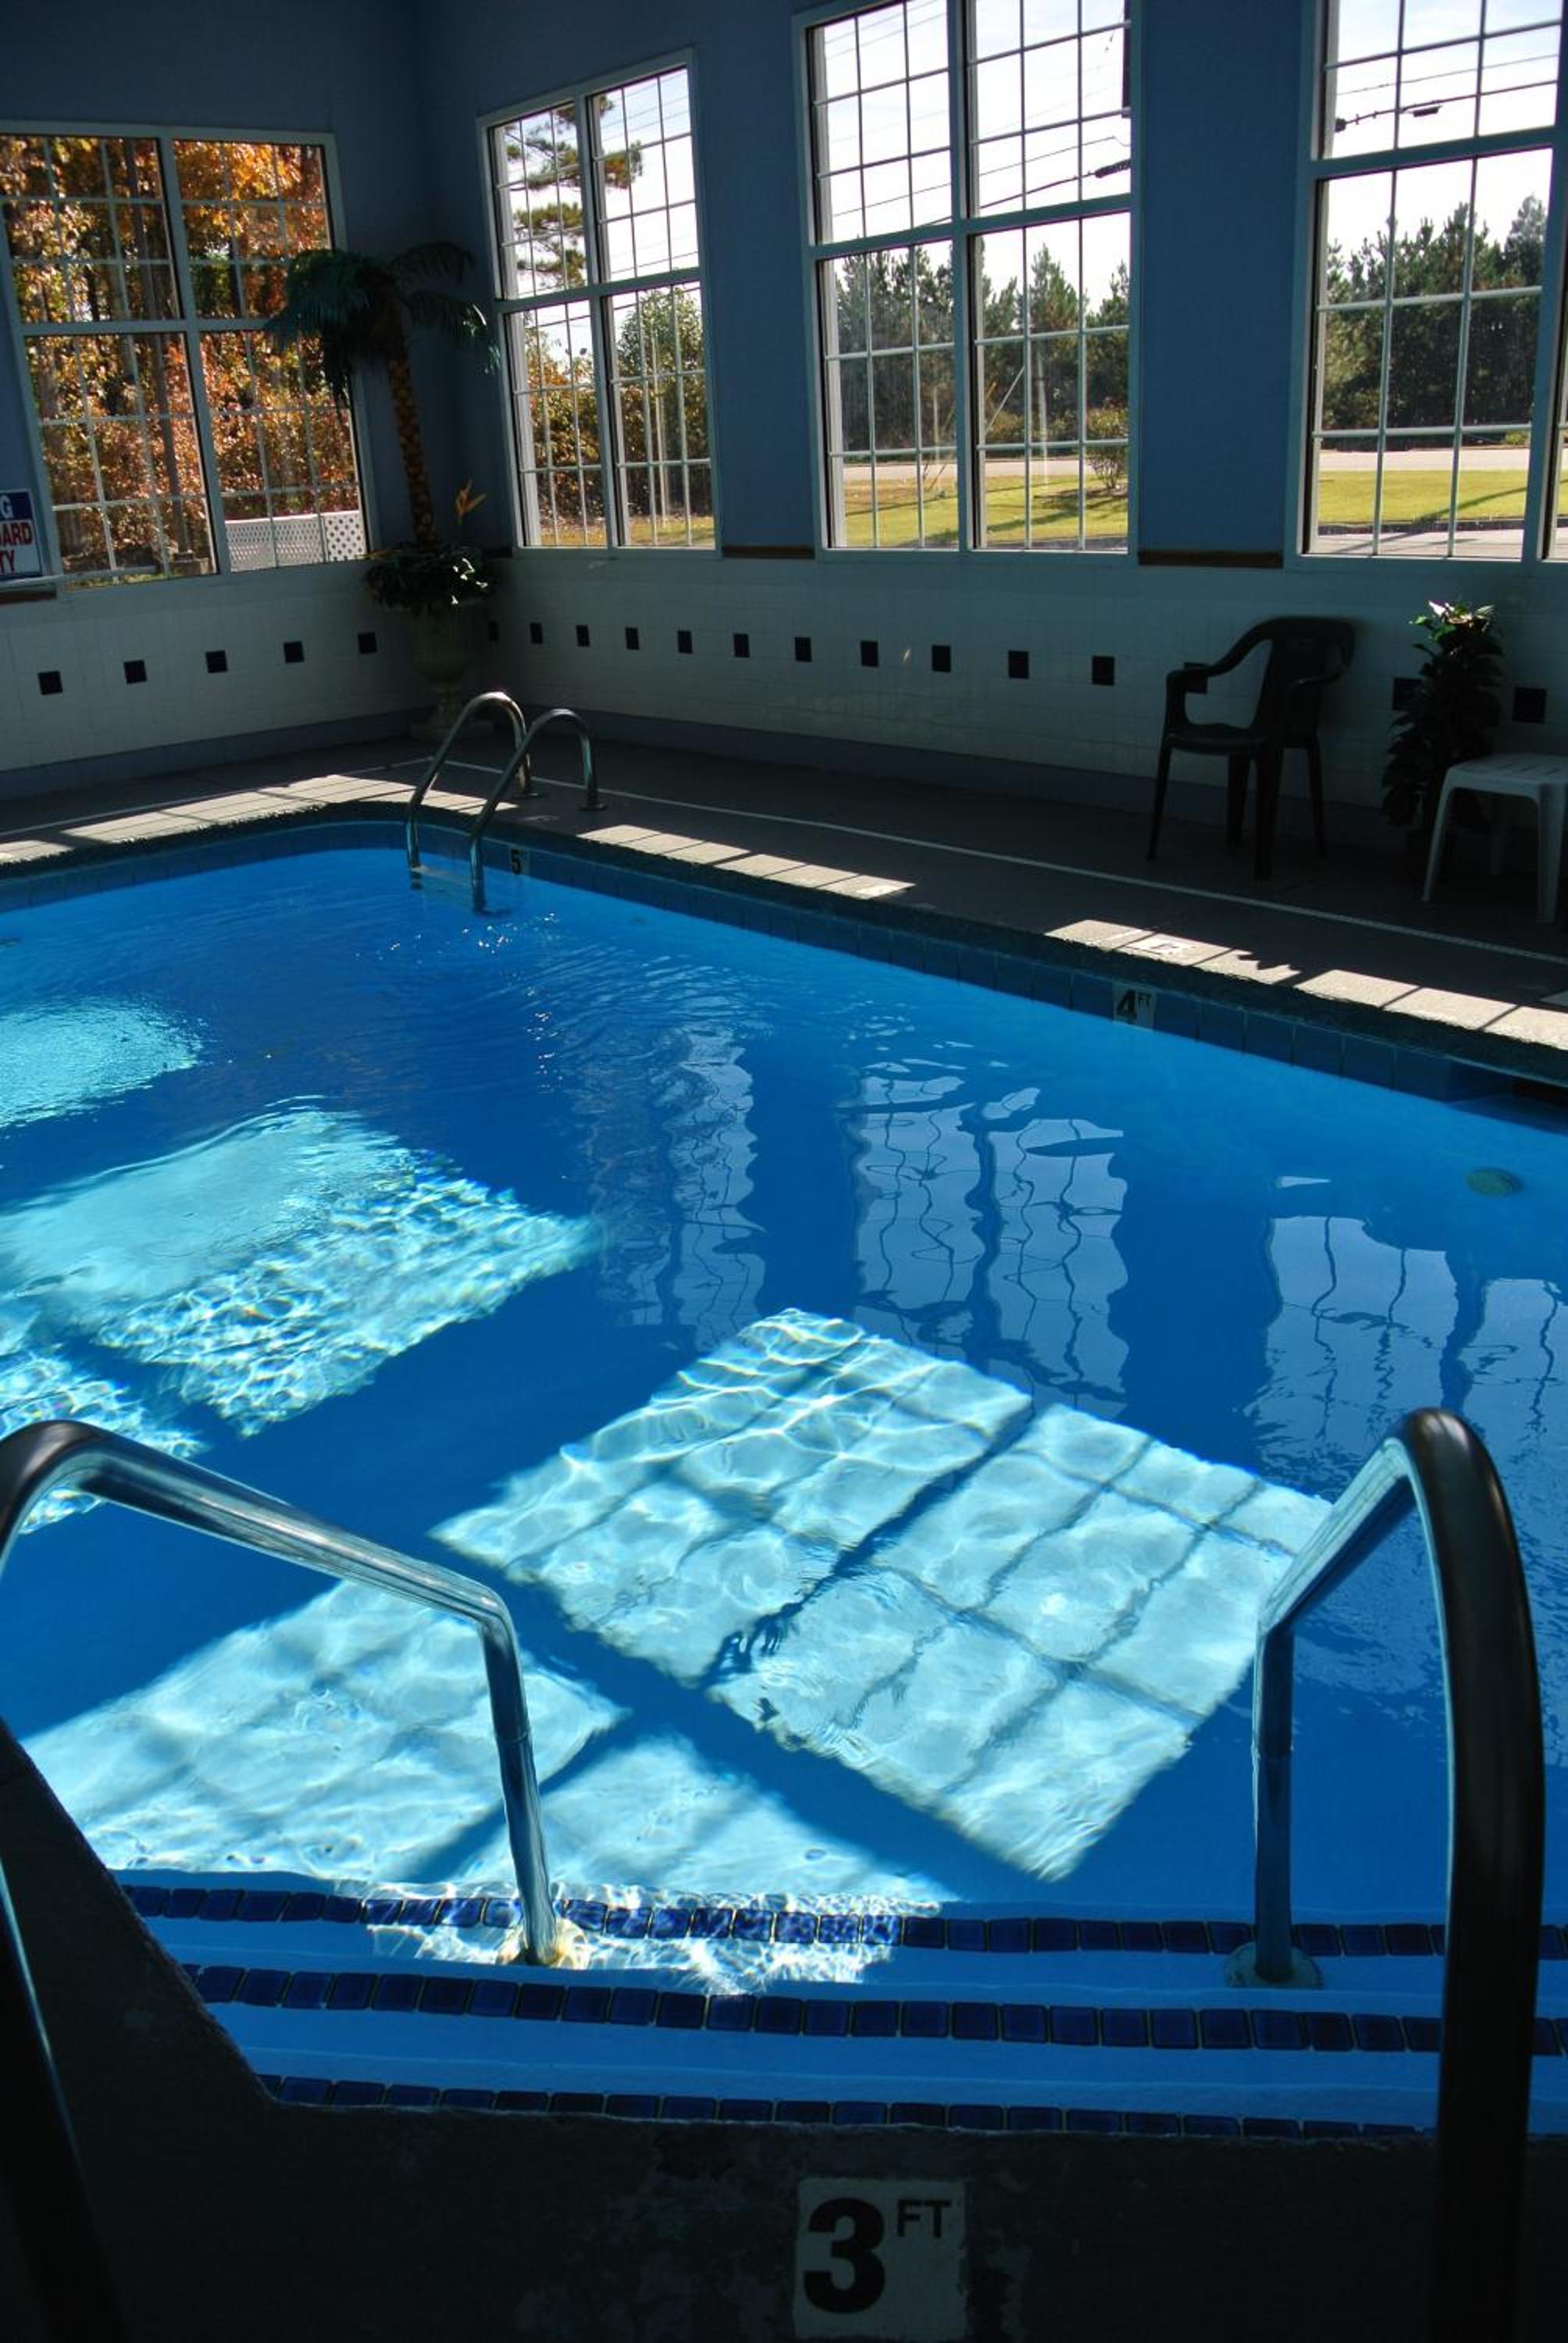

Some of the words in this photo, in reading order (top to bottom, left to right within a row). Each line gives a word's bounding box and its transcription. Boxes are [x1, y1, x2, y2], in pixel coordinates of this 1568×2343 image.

[0, 522, 32, 546] ARD
[511, 849, 521, 875] 5
[1117, 990, 1136, 1017] 4
[1139, 992, 1151, 1006] FT
[804, 2197, 886, 2313] 3
[898, 2199, 951, 2238] FT
